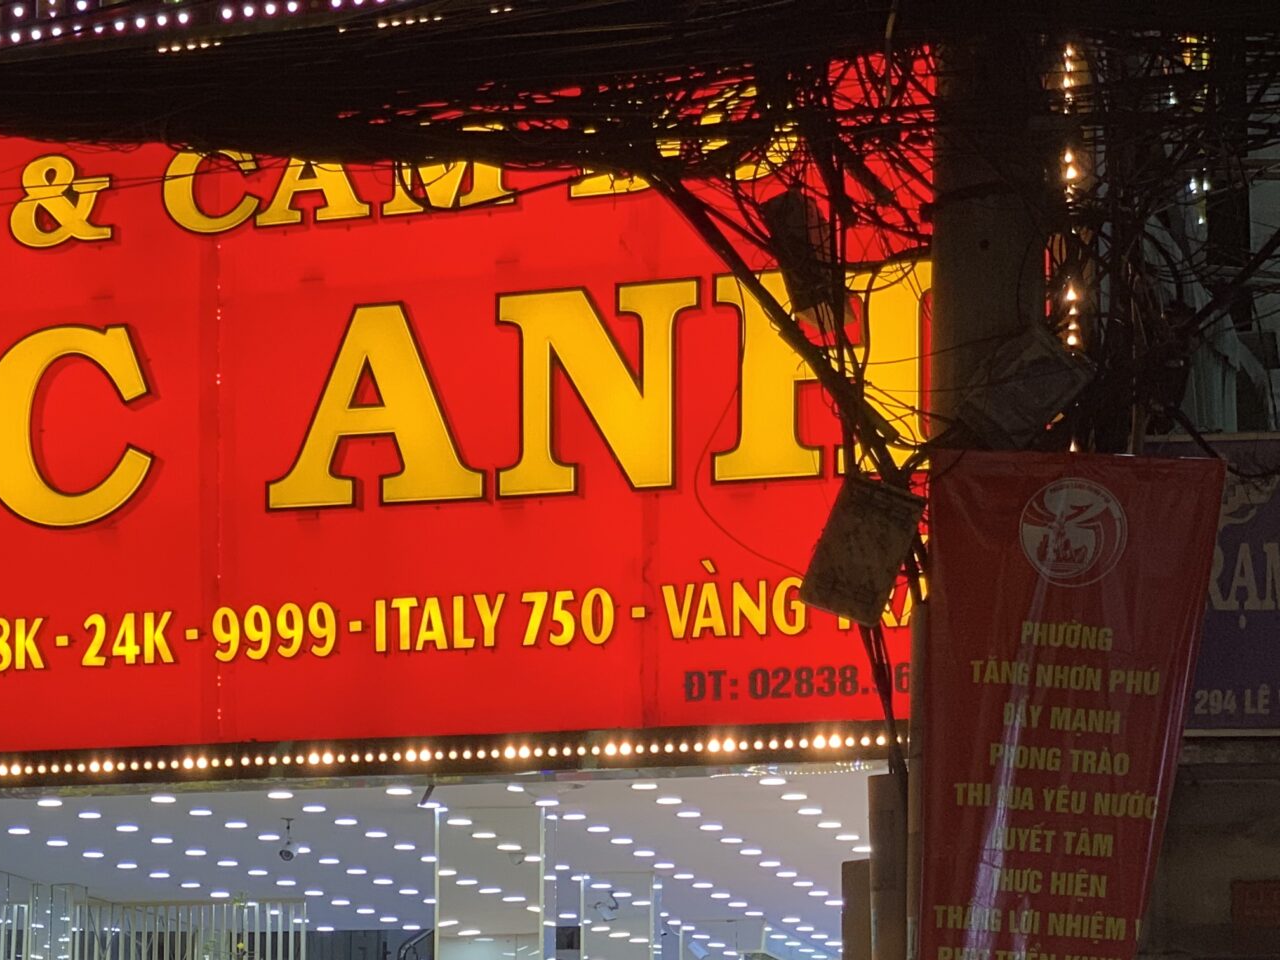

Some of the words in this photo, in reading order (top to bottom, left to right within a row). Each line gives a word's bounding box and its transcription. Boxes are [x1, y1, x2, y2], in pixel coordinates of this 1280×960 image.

[10, 155, 112, 248] &
[268, 262, 932, 511] ANH
[82, 611, 175, 667] 24K
[212, 601, 337, 662] 9999
[375, 593, 506, 652] ITALY
[521, 587, 615, 646] 750
[662, 559, 807, 639] VÀNG
[1020, 620, 1113, 651] PHƯỜNG
[684, 670, 738, 702] ĐT:
[970, 656, 1029, 687] TĂNG
[1035, 662, 1101, 692] NHƠN
[1108, 665, 1161, 696] PHÚ
[1194, 690, 1236, 716] 294
[1244, 683, 1270, 715] LÊ
[1049, 705, 1121, 736] MẠNH
[990, 743, 1061, 771] PHONG
[1070, 746, 1131, 776] TRÀO
[954, 783, 991, 807] THI
[1042, 786, 1086, 814] YÊU
[1064, 827, 1114, 857] TÂM
[1050, 872, 1107, 902] HIỆN
[1048, 908, 1126, 944] NHIỆM
